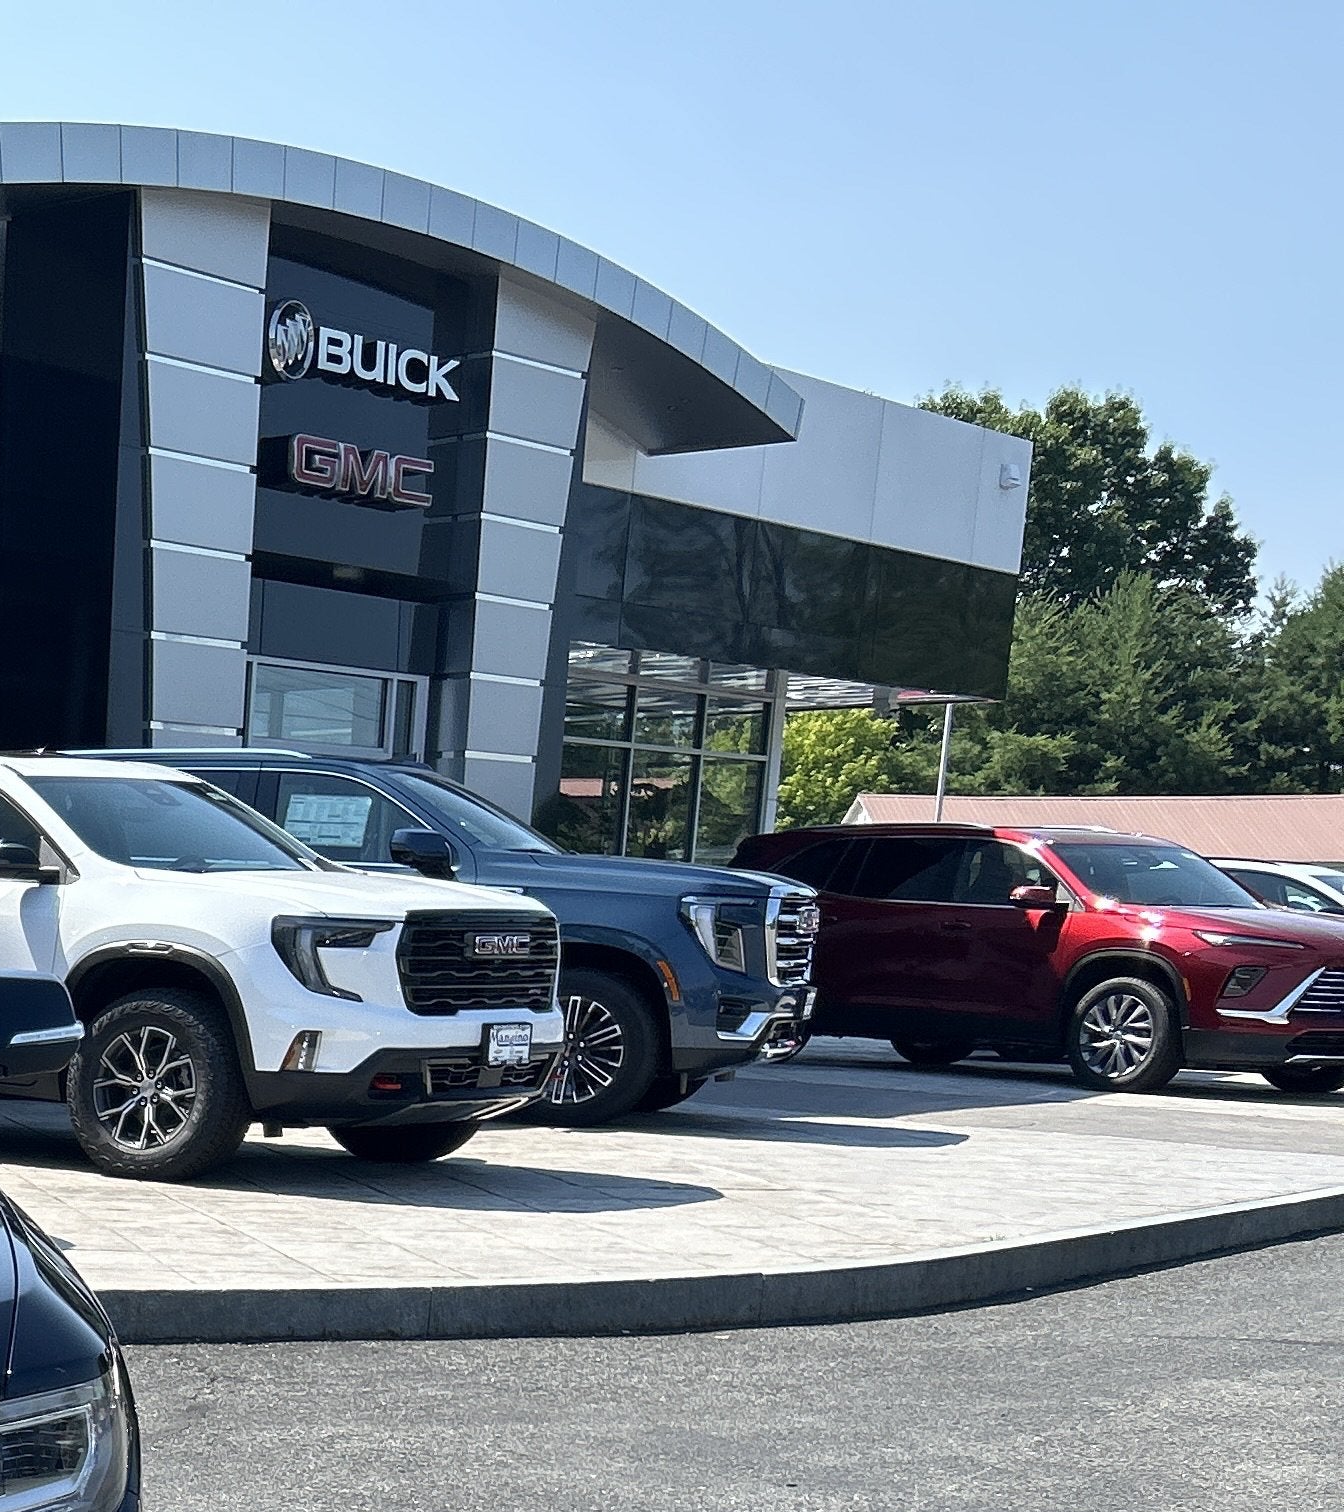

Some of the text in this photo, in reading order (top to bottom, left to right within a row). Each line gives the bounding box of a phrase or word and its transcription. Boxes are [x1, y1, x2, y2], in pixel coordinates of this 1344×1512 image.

[318, 326, 460, 401] BUICK
[294, 433, 434, 506] GMC
[475, 935, 530, 954] GMC
